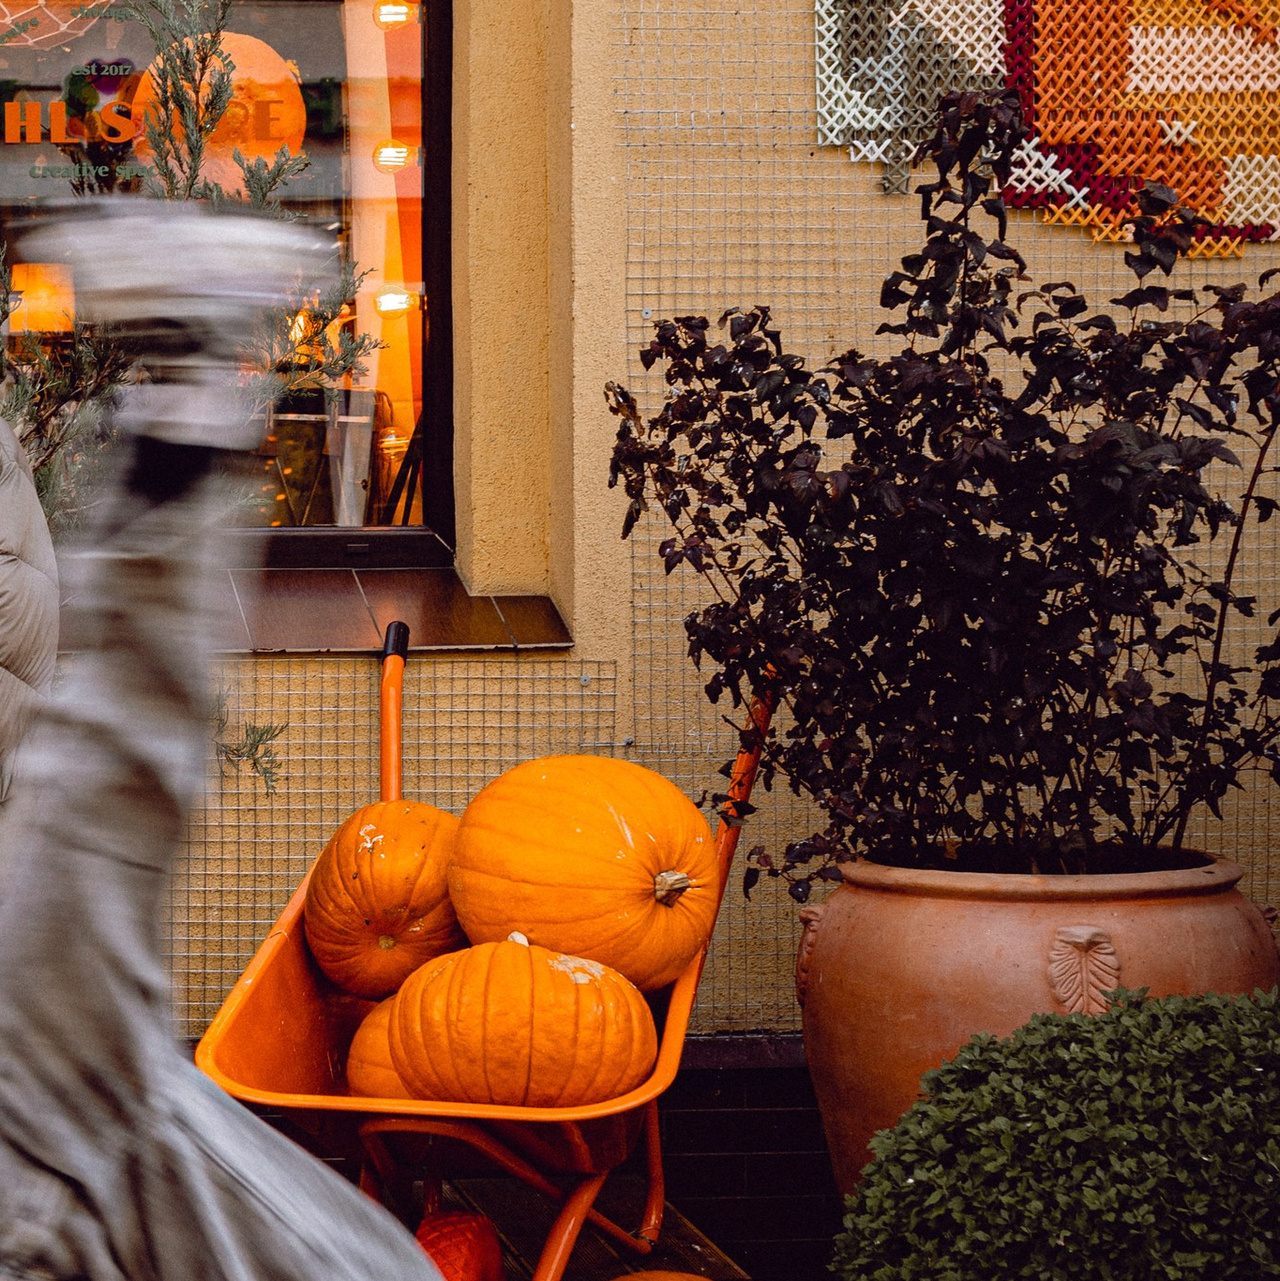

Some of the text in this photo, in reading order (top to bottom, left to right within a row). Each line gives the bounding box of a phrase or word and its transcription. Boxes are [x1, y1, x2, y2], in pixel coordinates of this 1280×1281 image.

[71, 63, 132, 76] est 2017
[29, 162, 162, 180] creative spac
